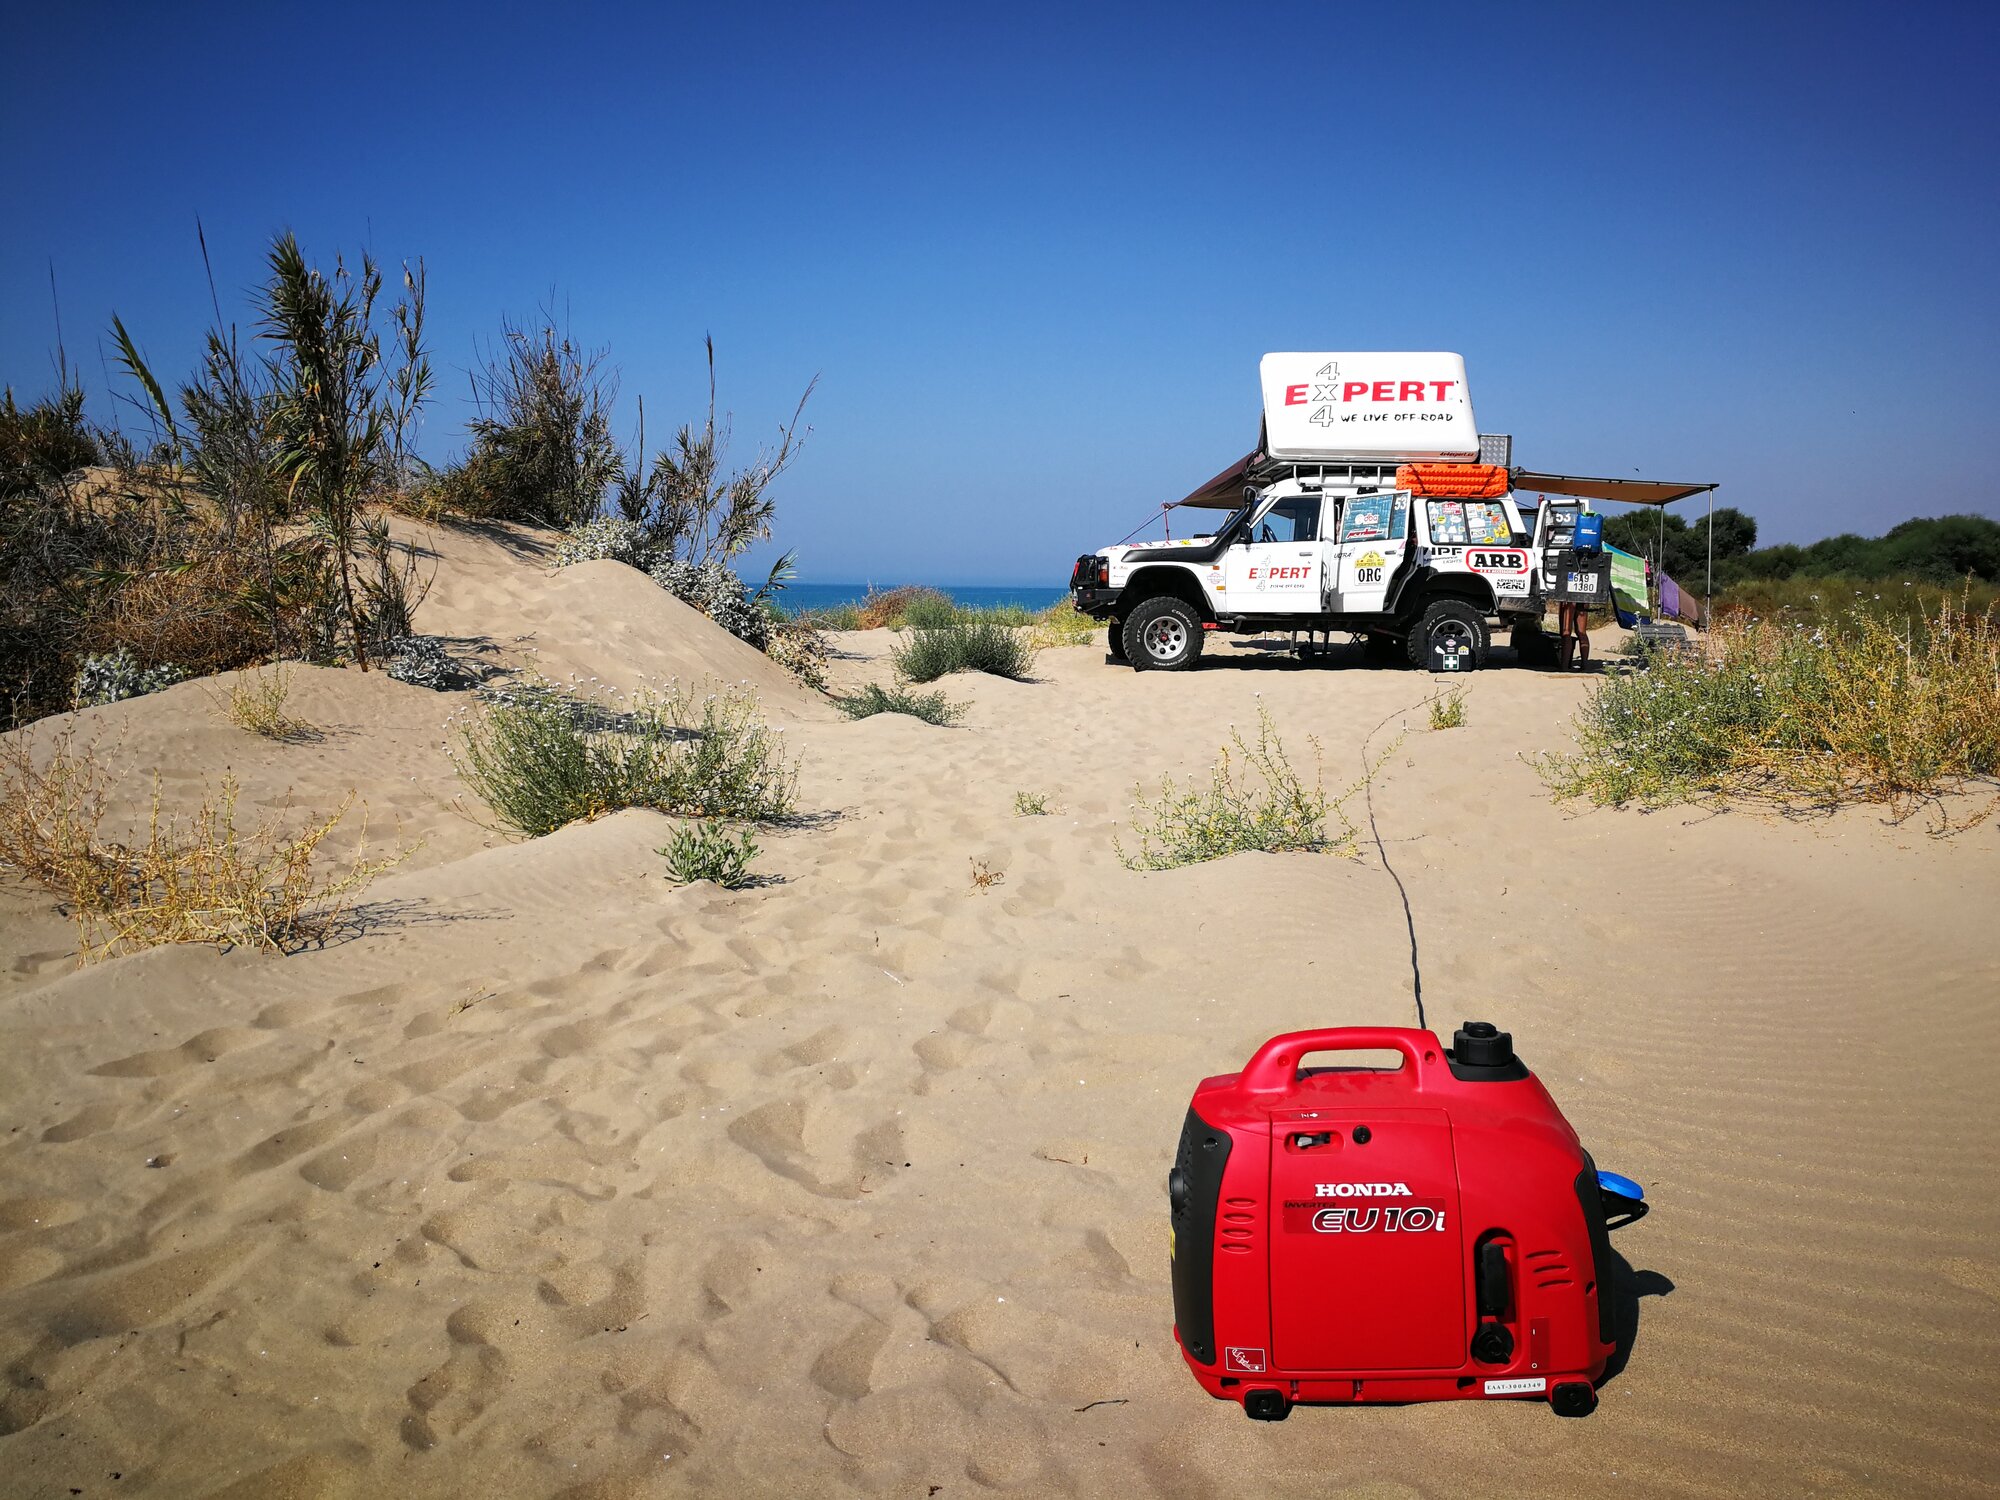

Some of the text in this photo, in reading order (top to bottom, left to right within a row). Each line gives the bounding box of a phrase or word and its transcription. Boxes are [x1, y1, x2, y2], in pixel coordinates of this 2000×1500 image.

[1316, 362, 1340, 380] 4
[1309, 405, 1334, 427] 4
[1341, 414, 1358, 422] WE
[1364, 413, 1389, 422] LIVE
[1394, 496, 1407, 510] 53
[1474, 553, 1523, 569] ARB
[1358, 568, 1381, 582] ORG
[1496, 582, 1525, 590] MENU
[1315, 1182, 1412, 1197] HONDA
